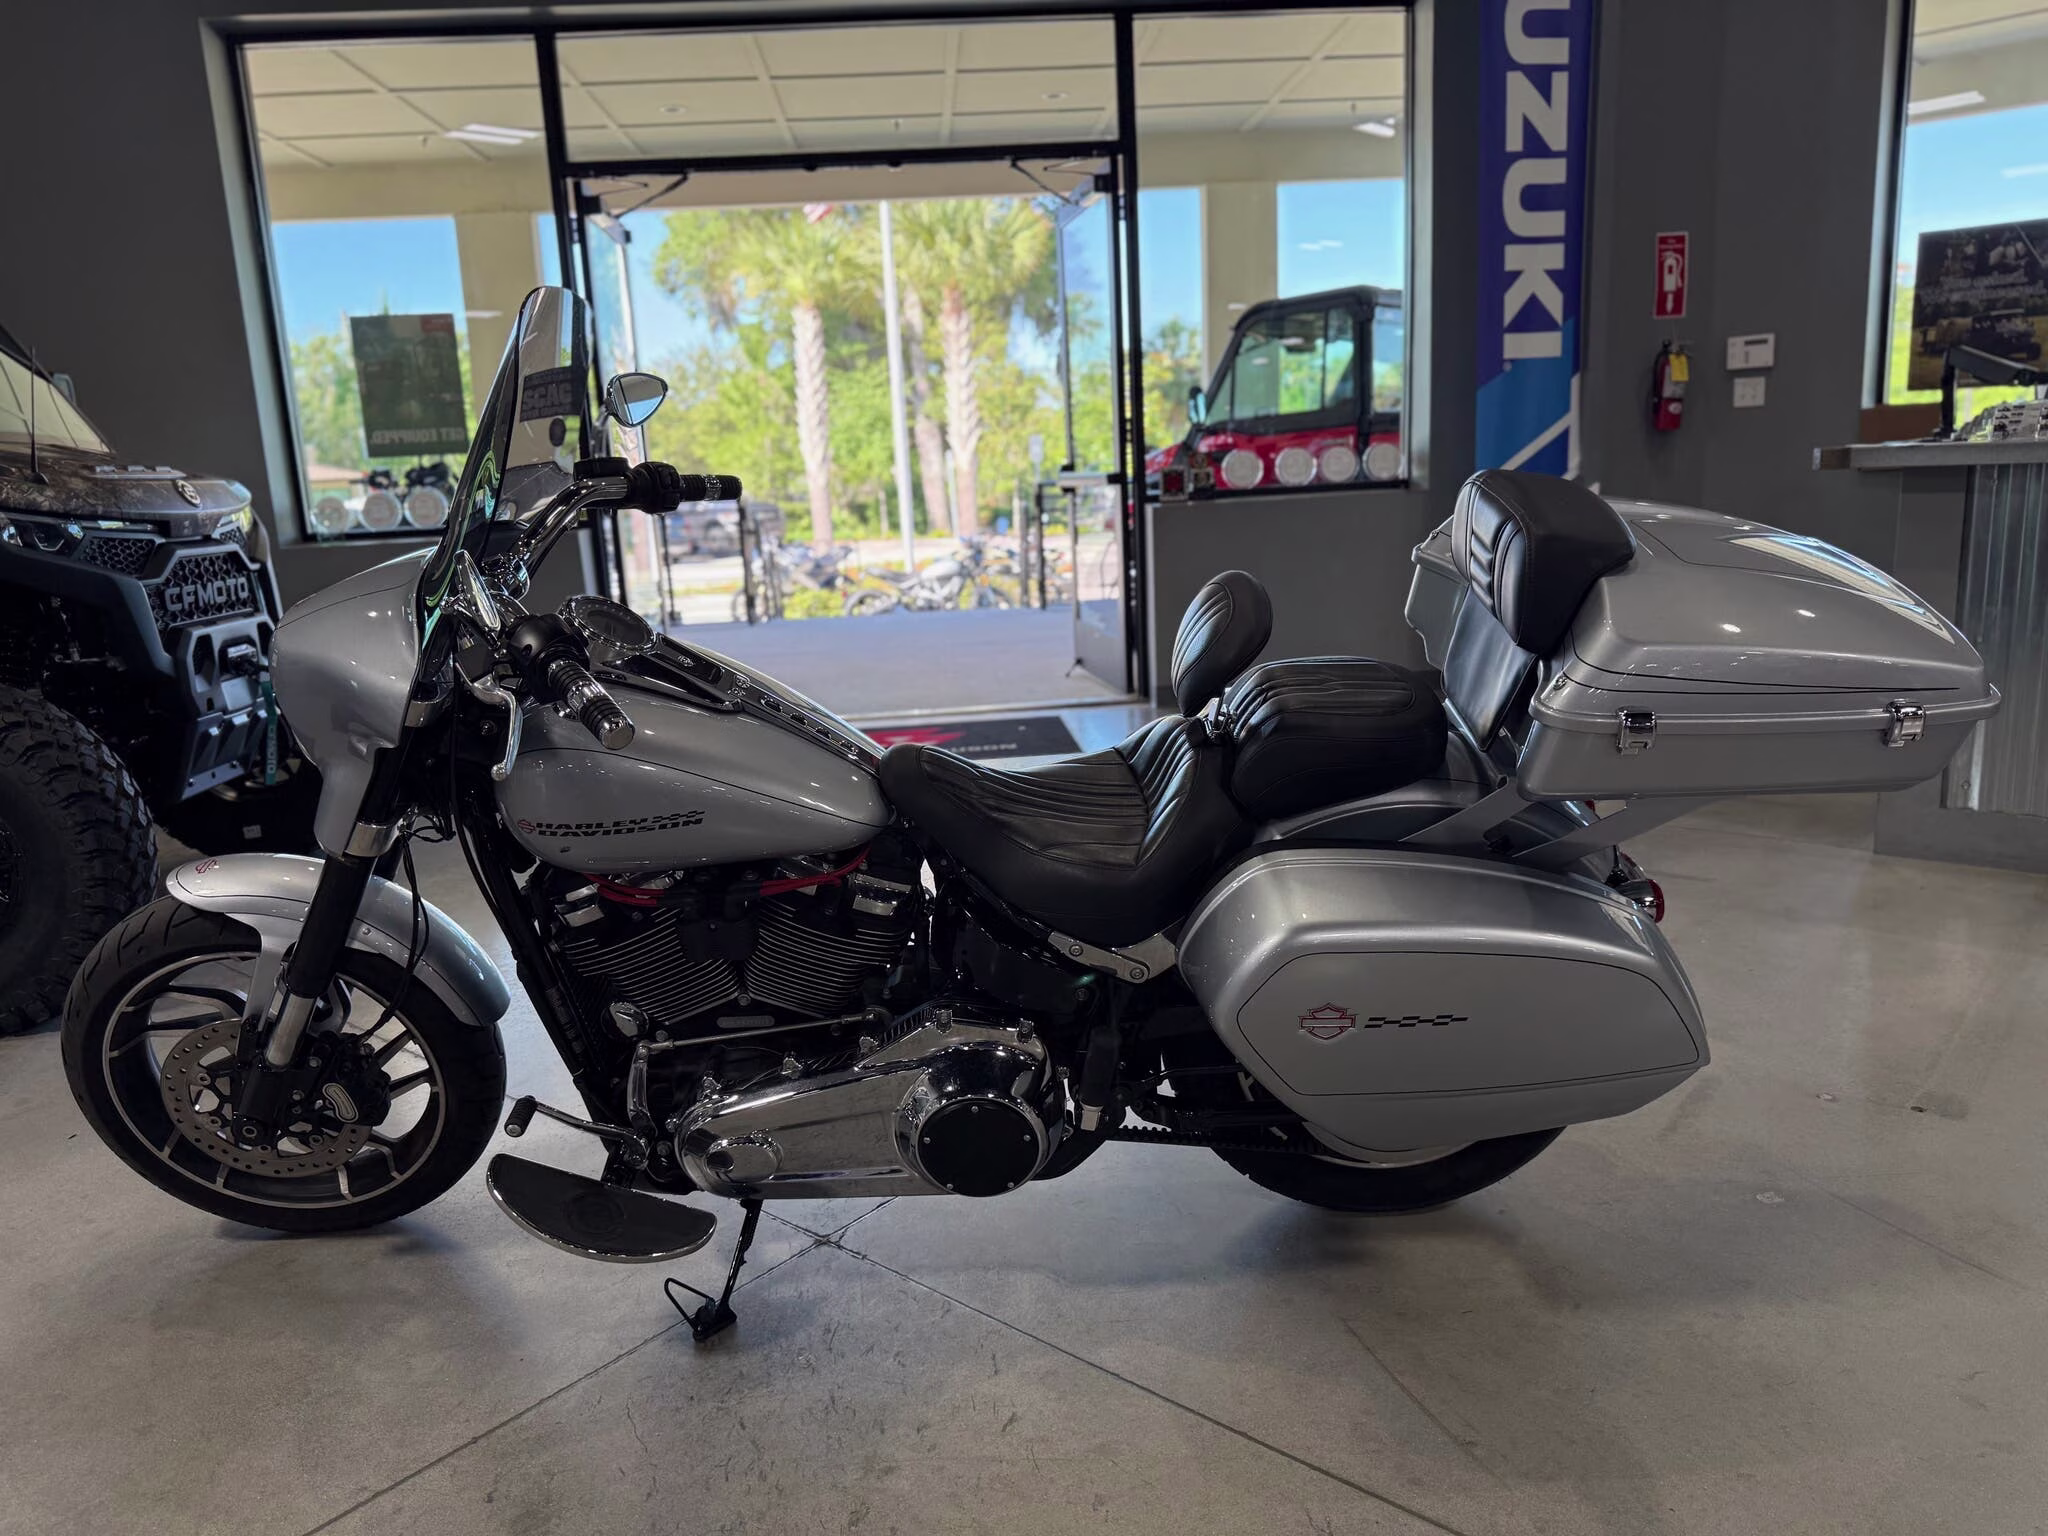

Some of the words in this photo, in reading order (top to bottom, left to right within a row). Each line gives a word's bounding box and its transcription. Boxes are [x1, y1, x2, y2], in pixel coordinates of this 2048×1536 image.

[164, 577, 249, 612] CFMOTO
[536, 818, 648, 830] HARLEY
[538, 818, 704, 837] DAVIDSON
